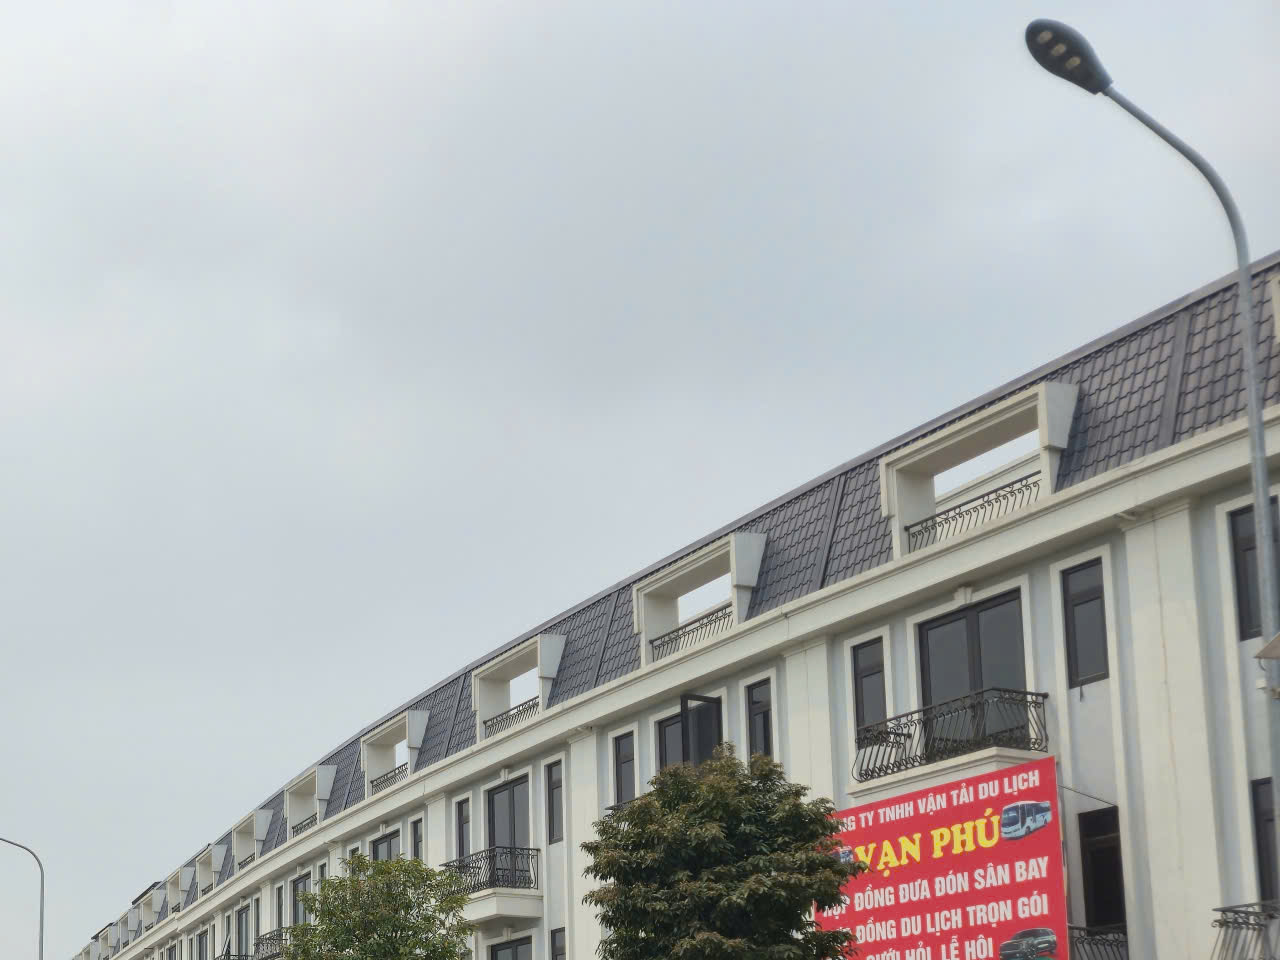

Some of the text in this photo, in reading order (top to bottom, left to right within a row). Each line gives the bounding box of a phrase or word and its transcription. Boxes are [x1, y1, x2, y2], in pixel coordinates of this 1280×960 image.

[858, 811, 874, 828] TY
[878, 801, 914, 824] TNHH
[918, 793, 947, 815] VẬN
[951, 782, 974, 806] TẢI
[978, 780, 999, 800] DU
[1004, 769, 1039, 795] LỊCH
[855, 808, 1000, 877] VẠN PHÚ
[854, 884, 895, 911] ĐỒNG
[899, 878, 930, 903] ĐƯA
[935, 870, 969, 897] ĐÓN
[974, 863, 1010, 889] SÂN
[1015, 856, 1049, 882] BAY
[856, 890, 1049, 944] ĐỒNG DU LỊCH TRỌN GÓI
